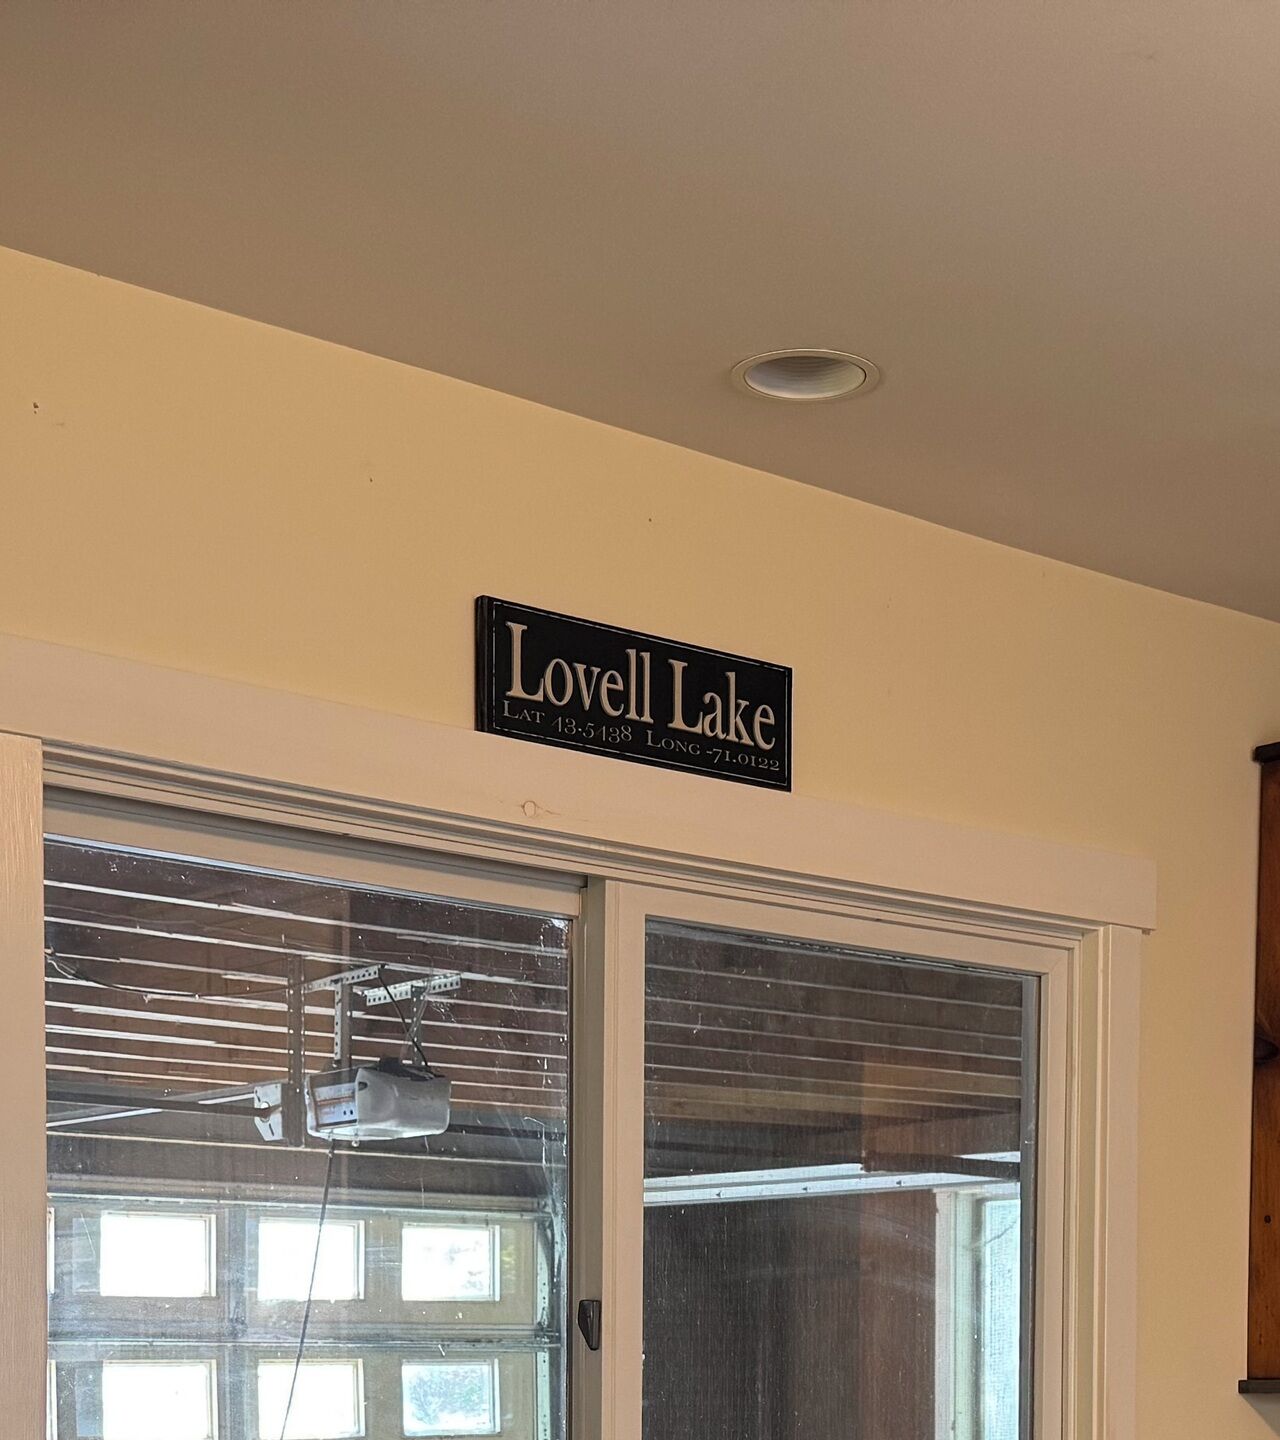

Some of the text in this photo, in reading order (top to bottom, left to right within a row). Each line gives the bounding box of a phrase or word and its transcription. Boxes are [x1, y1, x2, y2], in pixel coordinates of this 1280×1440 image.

[504, 620, 777, 752] Lovell Lake
[705, 747, 780, 771] -71.0122
